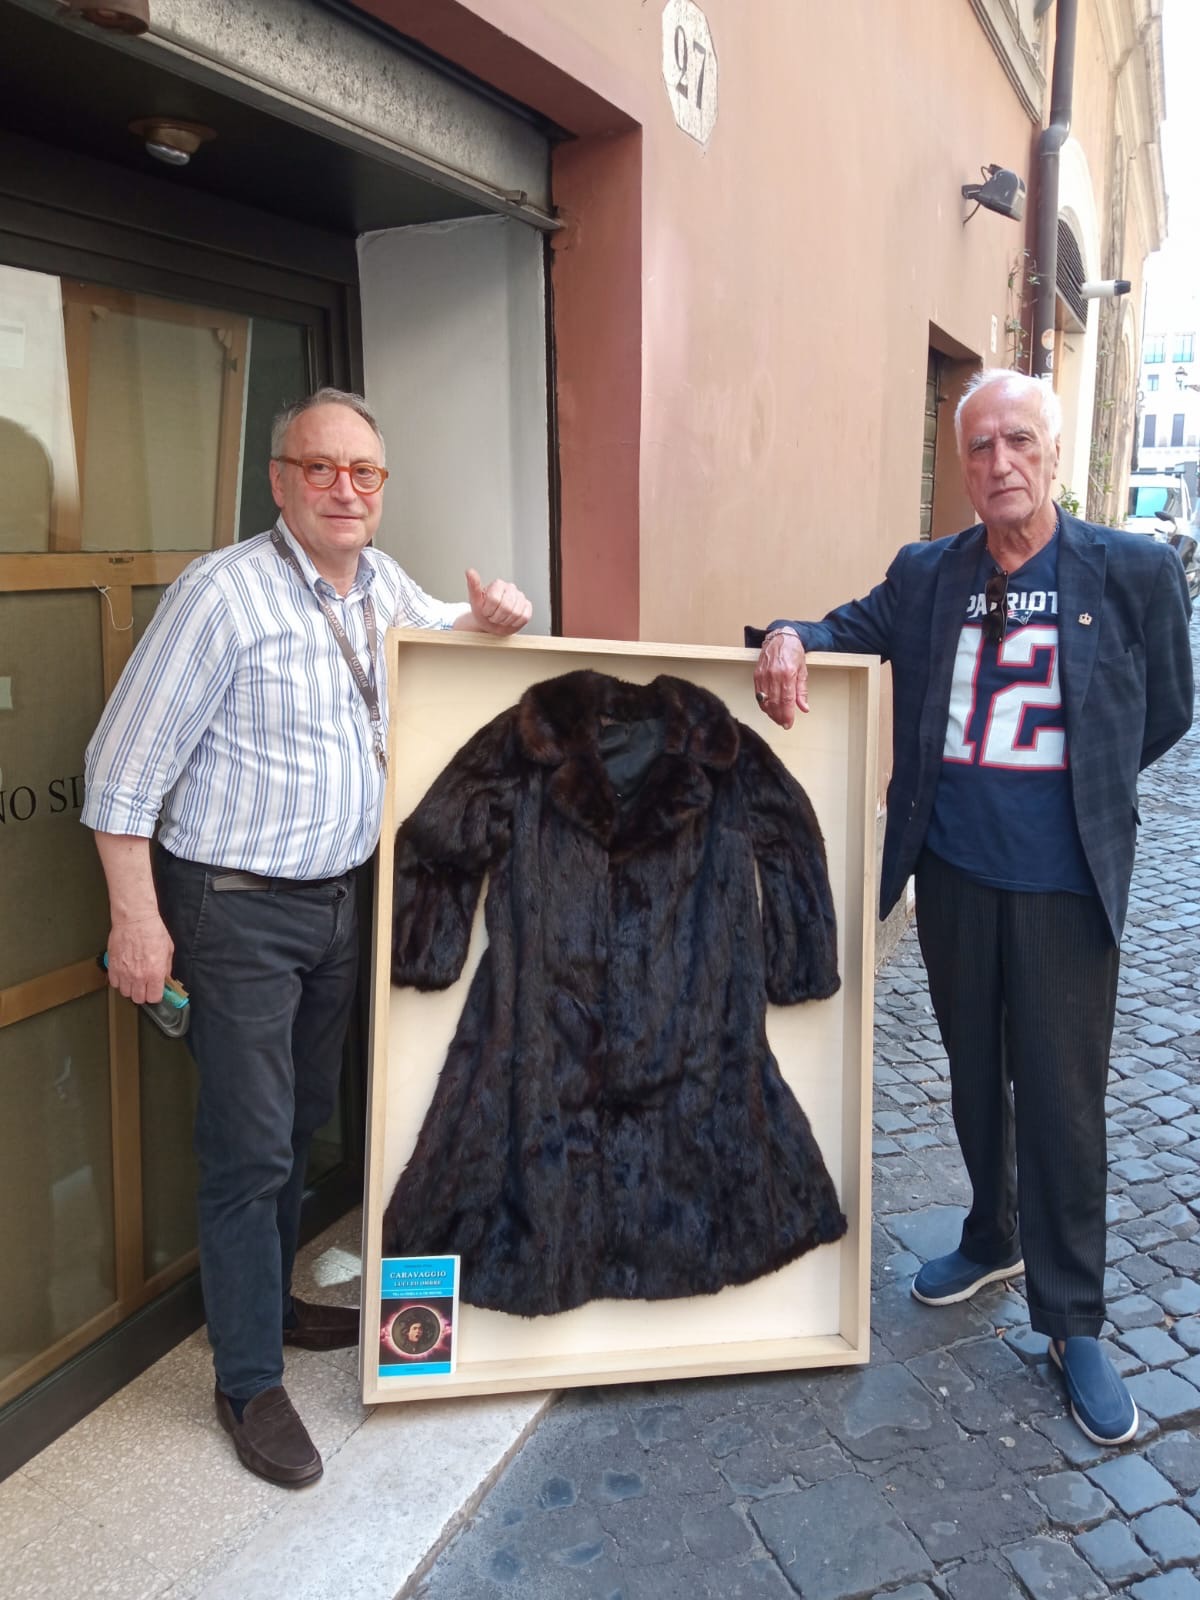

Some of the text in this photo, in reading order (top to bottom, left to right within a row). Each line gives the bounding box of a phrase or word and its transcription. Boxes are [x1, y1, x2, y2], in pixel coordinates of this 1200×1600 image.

[674, 25, 706, 110] 27
[942, 624, 1068, 770] 12
[389, 1270, 447, 1279] CARAVAGGIO
